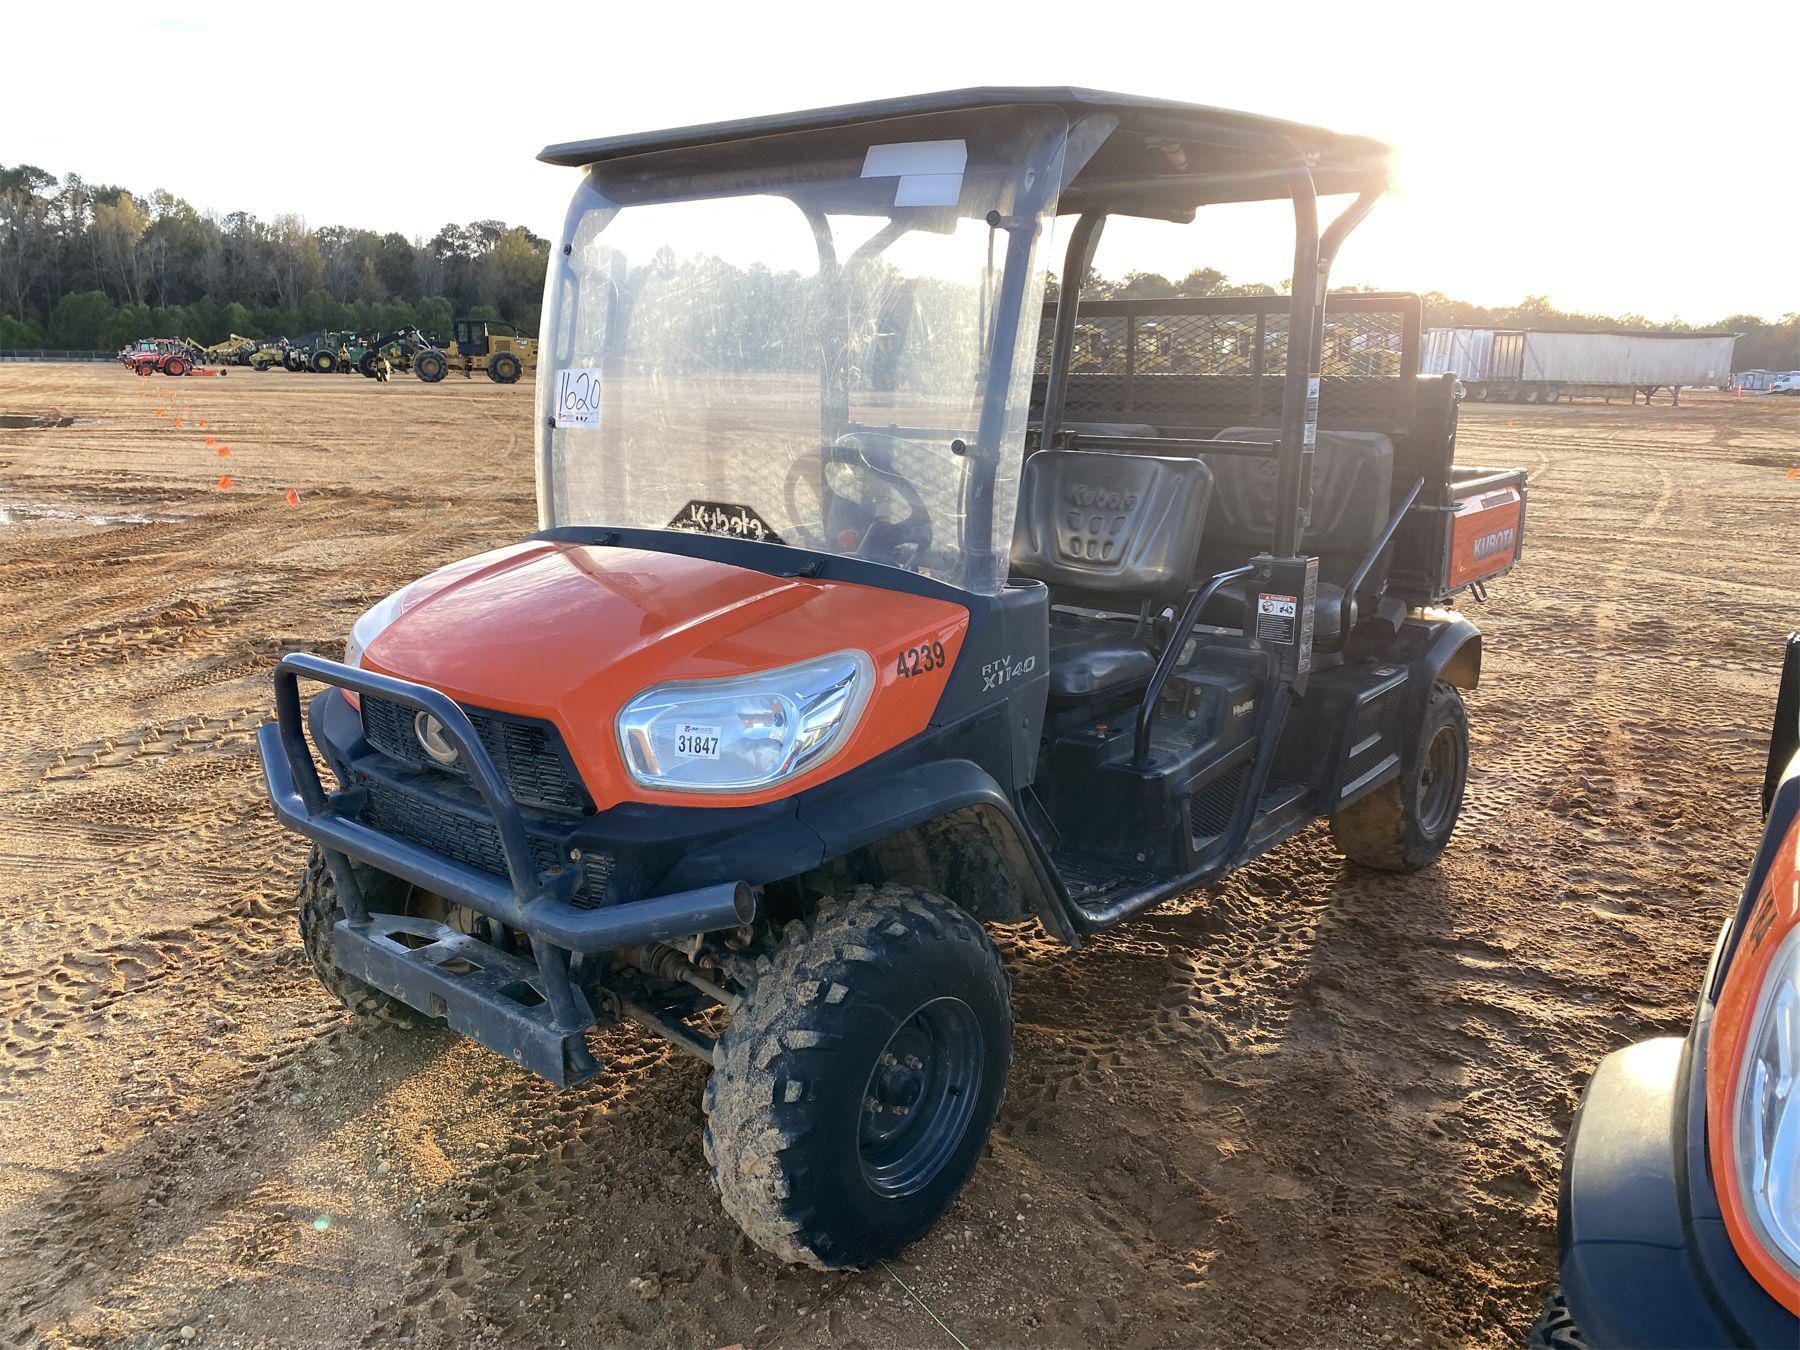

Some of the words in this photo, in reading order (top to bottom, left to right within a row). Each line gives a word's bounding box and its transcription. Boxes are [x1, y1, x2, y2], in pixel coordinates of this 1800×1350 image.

[559, 372, 601, 412] 1620
[1473, 528, 1514, 560] KUBOTA
[896, 641, 946, 678] 4239
[982, 655, 1011, 676] RTV
[982, 655, 1036, 692] X1140
[678, 735, 719, 754] 31847
